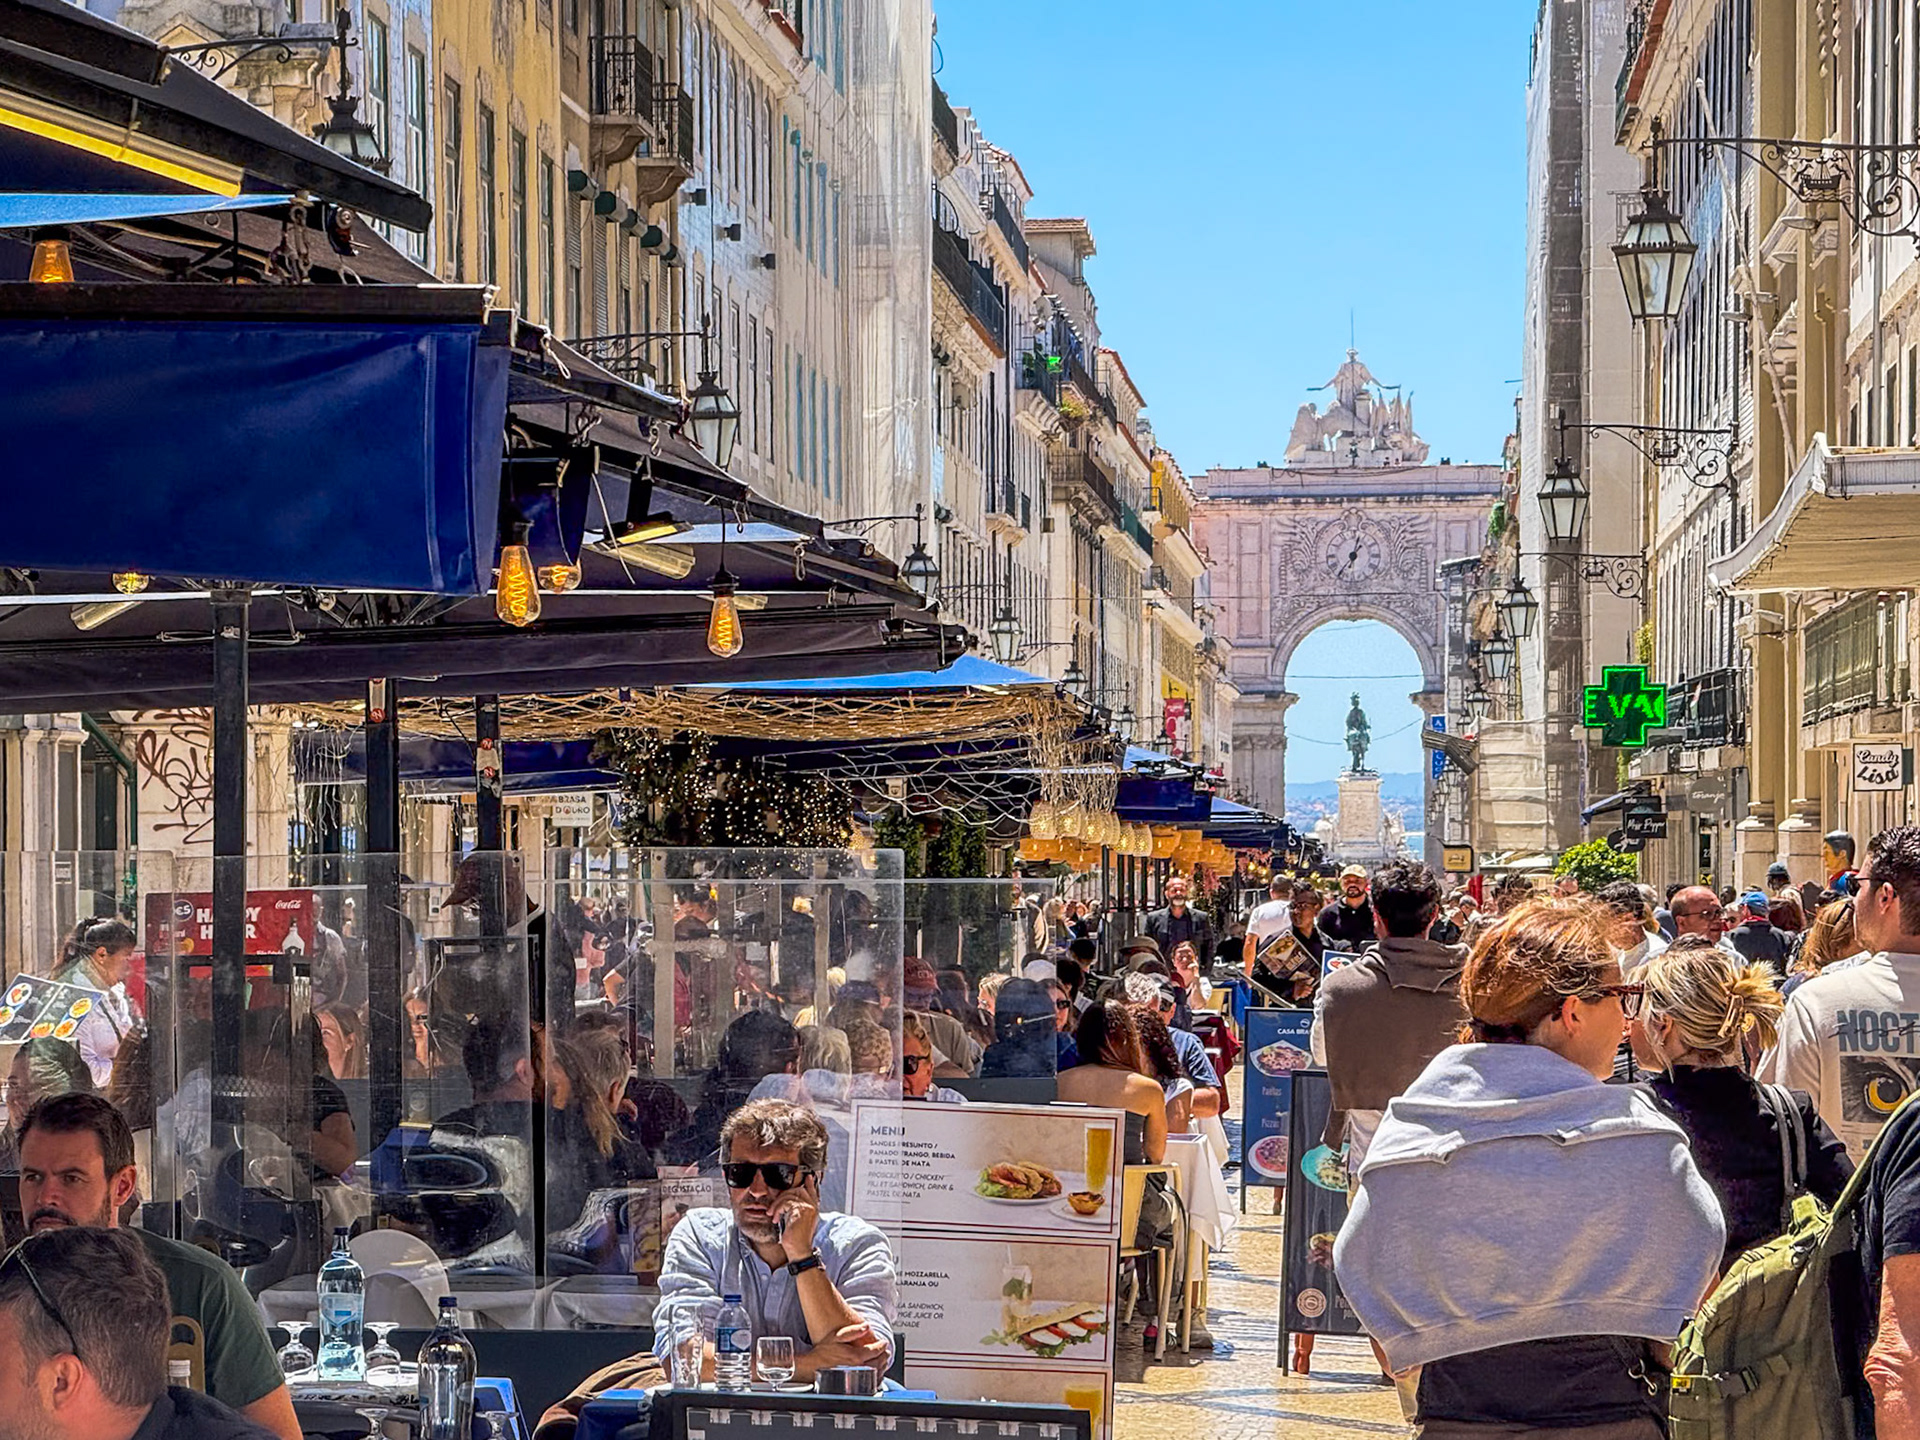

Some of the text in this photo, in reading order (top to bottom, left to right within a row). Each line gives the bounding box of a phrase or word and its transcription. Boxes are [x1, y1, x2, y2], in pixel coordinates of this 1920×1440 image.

[1856, 749, 1899, 769] Candy
[1856, 765, 1899, 785] Lisa
[1836, 1008, 1920, 1055] NOCT
[870, 1125, 905, 1136] MENU
[914, 1173, 944, 1181] CHICKEN
[927, 1183, 947, 1191] DRINK
[904, 1271, 950, 1279] MOZZARELLA,
